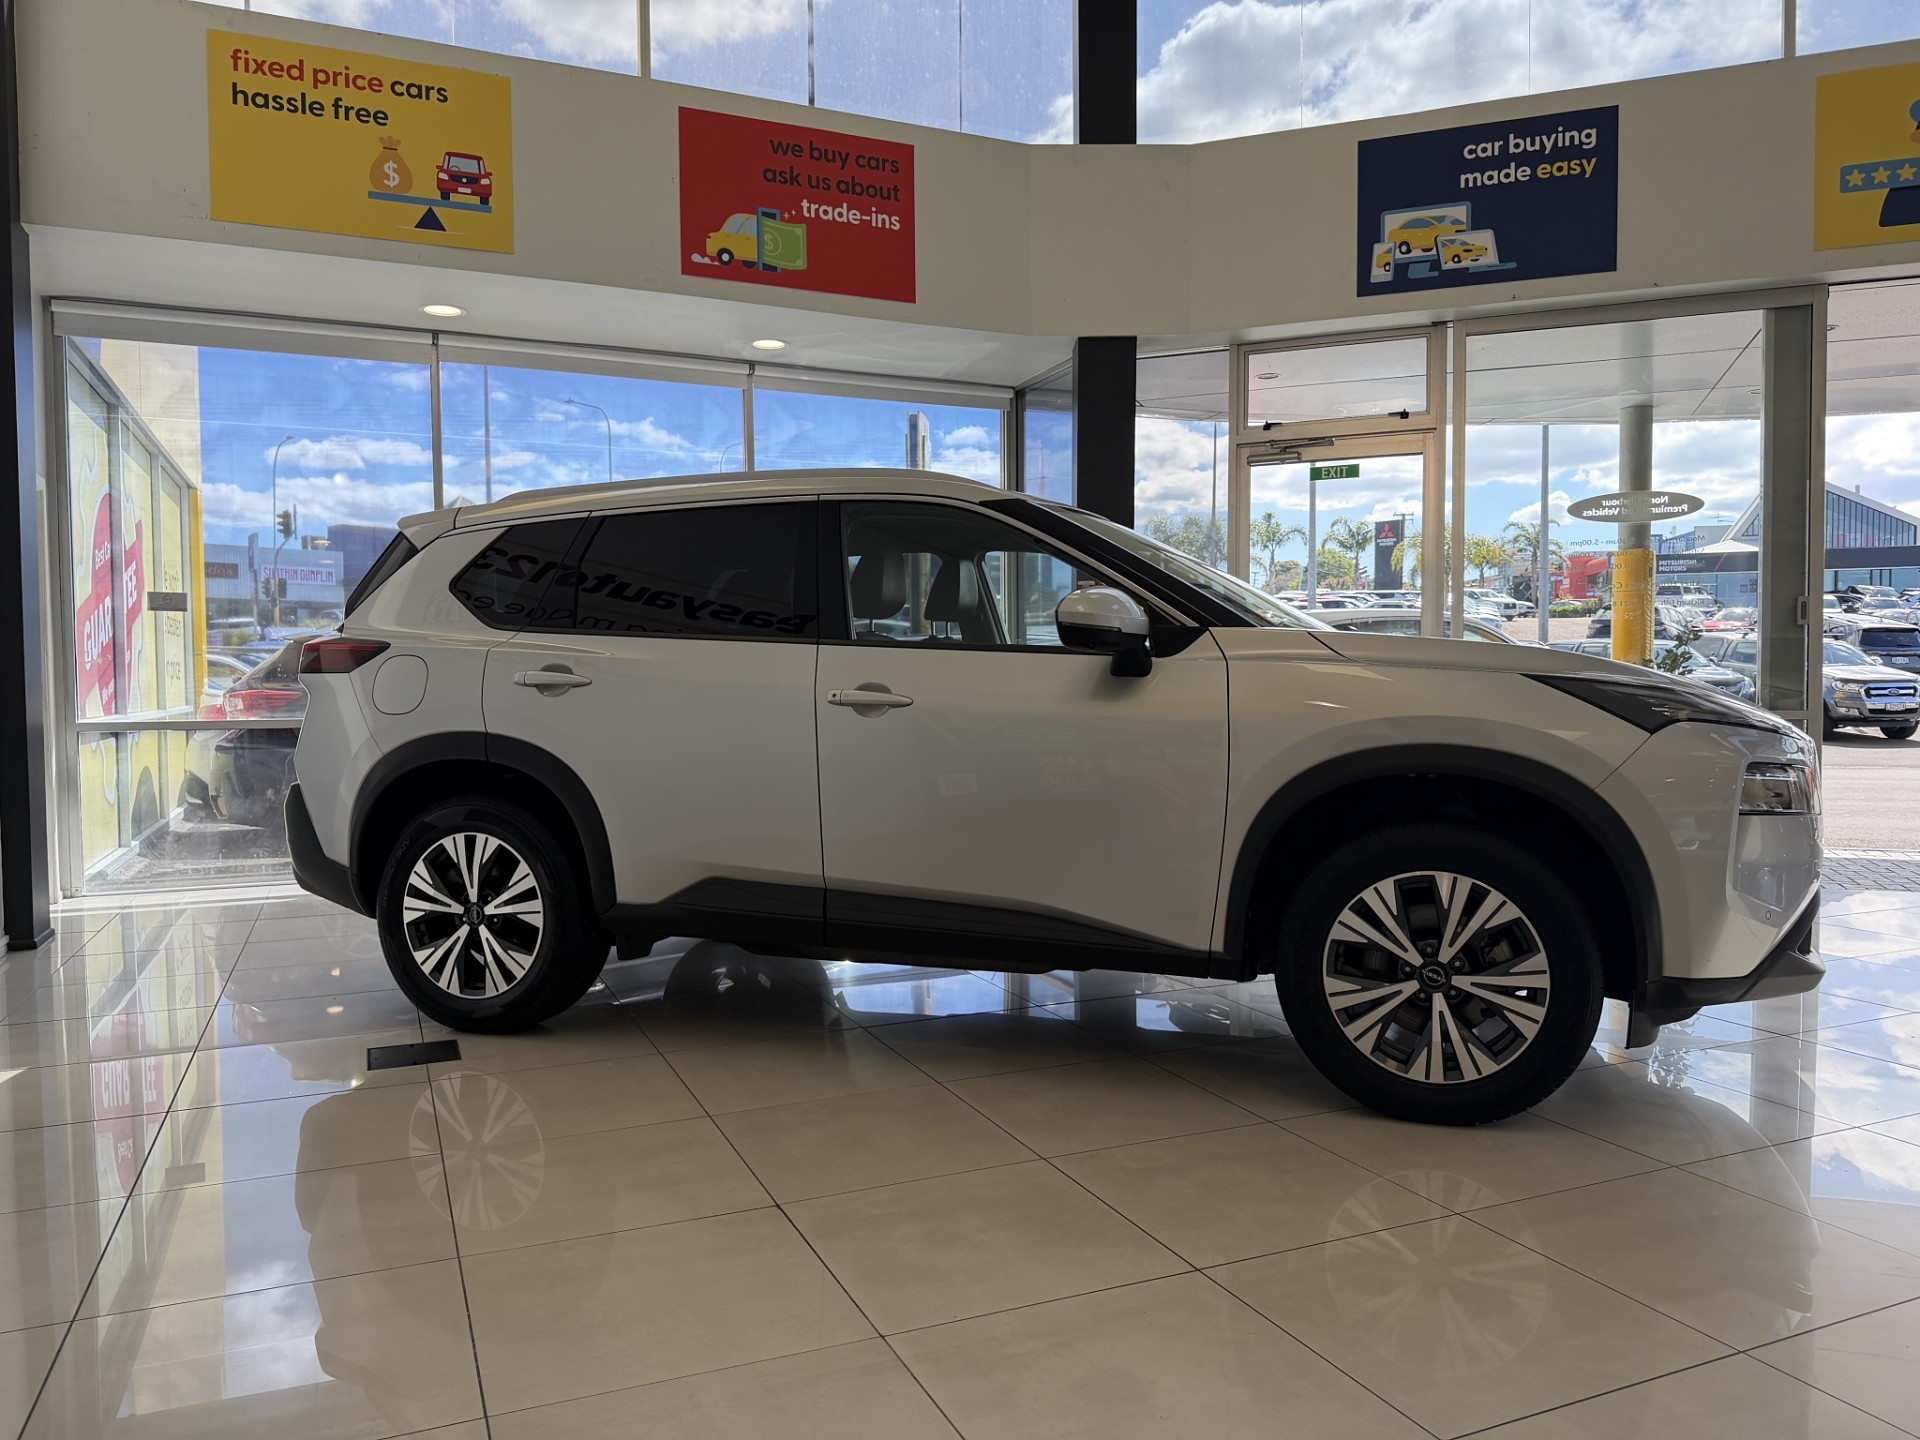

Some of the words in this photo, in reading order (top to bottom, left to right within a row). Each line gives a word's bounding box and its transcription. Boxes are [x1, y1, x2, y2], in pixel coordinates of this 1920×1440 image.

[230, 49, 304, 82] fixed
[312, 65, 384, 94] price
[390, 78, 449, 104] cars
[231, 82, 325, 118] hassle
[332, 97, 390, 127] free
[769, 139, 804, 158] we
[809, 141, 850, 170] buy
[855, 153, 900, 174] cars
[1463, 140, 1503, 160] car
[1508, 126, 1597, 155] buying
[383, 160, 400, 188] $
[762, 166, 801, 187] ask
[807, 173, 832, 192] us
[836, 176, 900, 202] about
[1460, 162, 1531, 188] made
[1536, 156, 1597, 179] easy
[801, 199, 901, 231] trade-ins
[1321, 466, 1348, 479] EXIT
[300, 569, 334, 584] DUMPLIN
[1422, 969, 1446, 982] NISSAN
